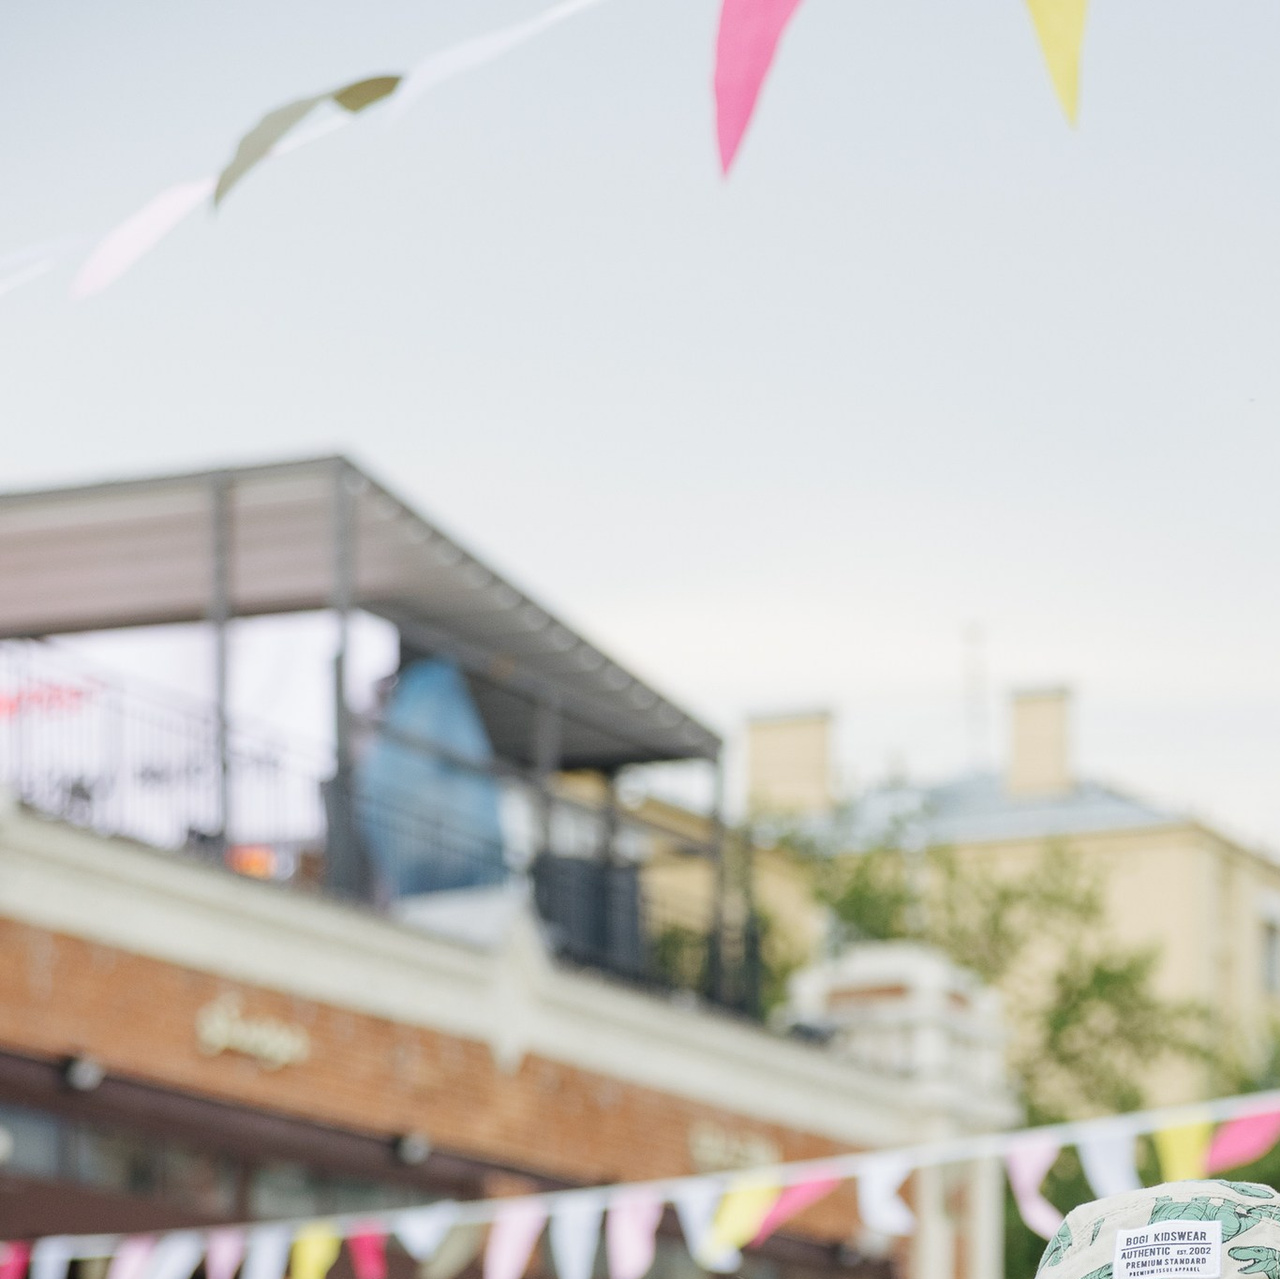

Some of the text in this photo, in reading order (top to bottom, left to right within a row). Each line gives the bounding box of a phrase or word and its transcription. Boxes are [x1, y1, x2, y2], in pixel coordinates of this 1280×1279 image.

[1126, 1231, 1207, 1246] BOGI KIDSWEAR
[1121, 1247, 1171, 1260] AUTHENTIC
[1189, 1246, 1211, 1255] 2002
[1126, 1257, 1207, 1269] PREMIUM STANDARD
[1129, 1269, 1155, 1277] PREMIUM
